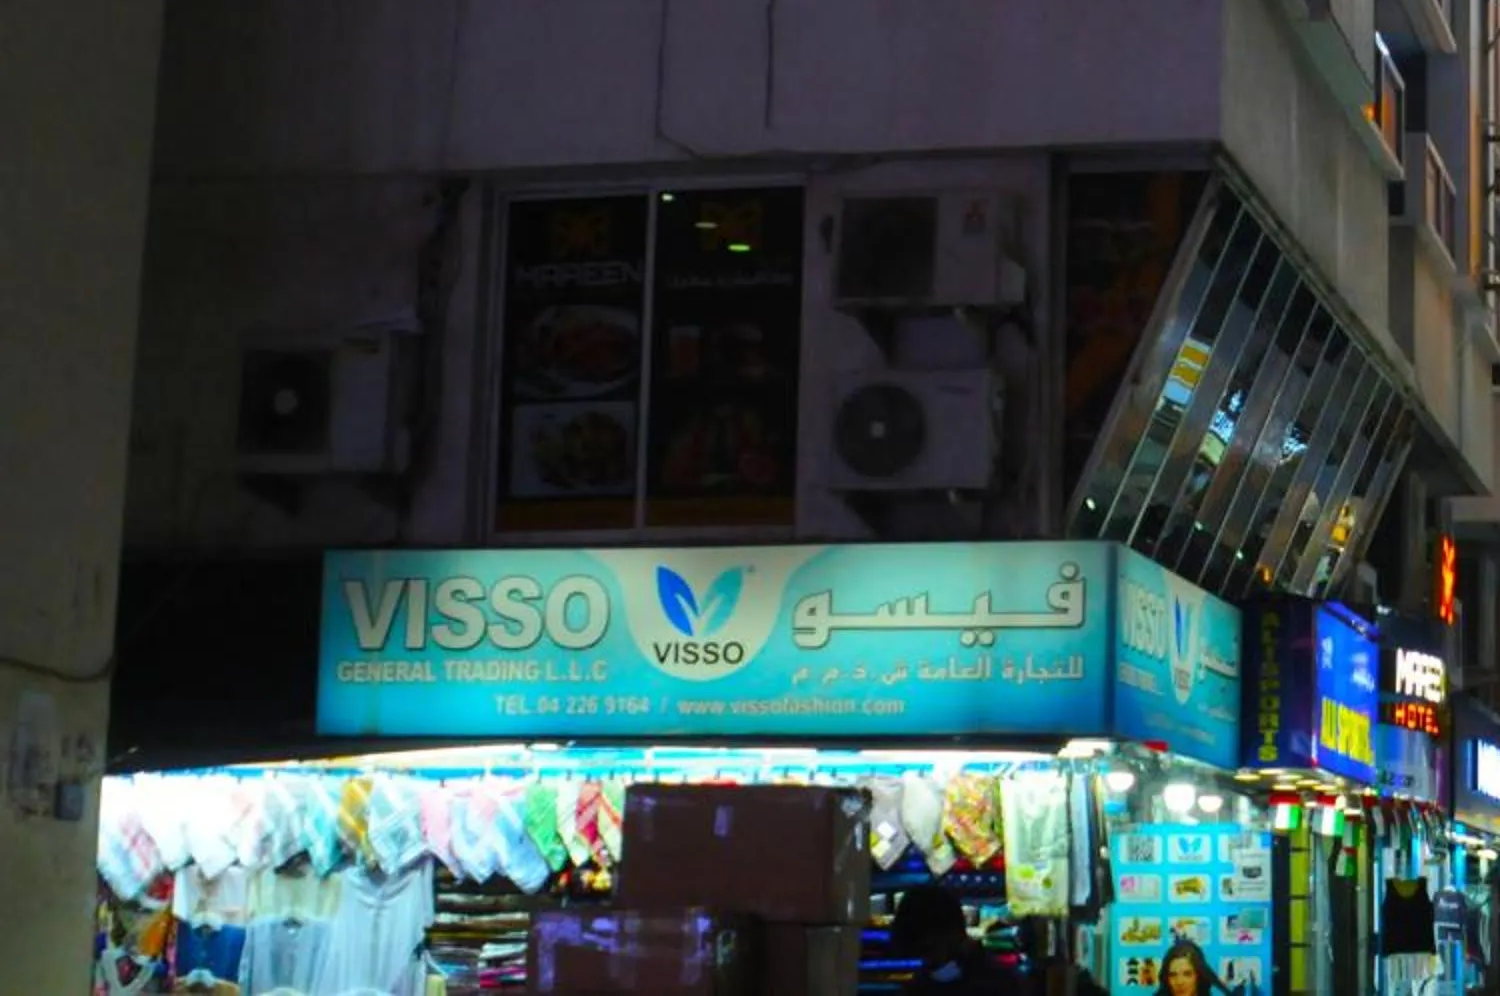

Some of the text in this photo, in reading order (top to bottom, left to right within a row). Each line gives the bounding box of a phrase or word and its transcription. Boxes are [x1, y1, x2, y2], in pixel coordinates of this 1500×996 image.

[342, 575, 611, 652] VISSO
[792, 562, 1087, 650] فيسو
[652, 641, 745, 666] VISSO
[337, 660, 437, 683] GENERAL
[443, 660, 539, 682] TRADING
[917, 655, 991, 681] العامة
